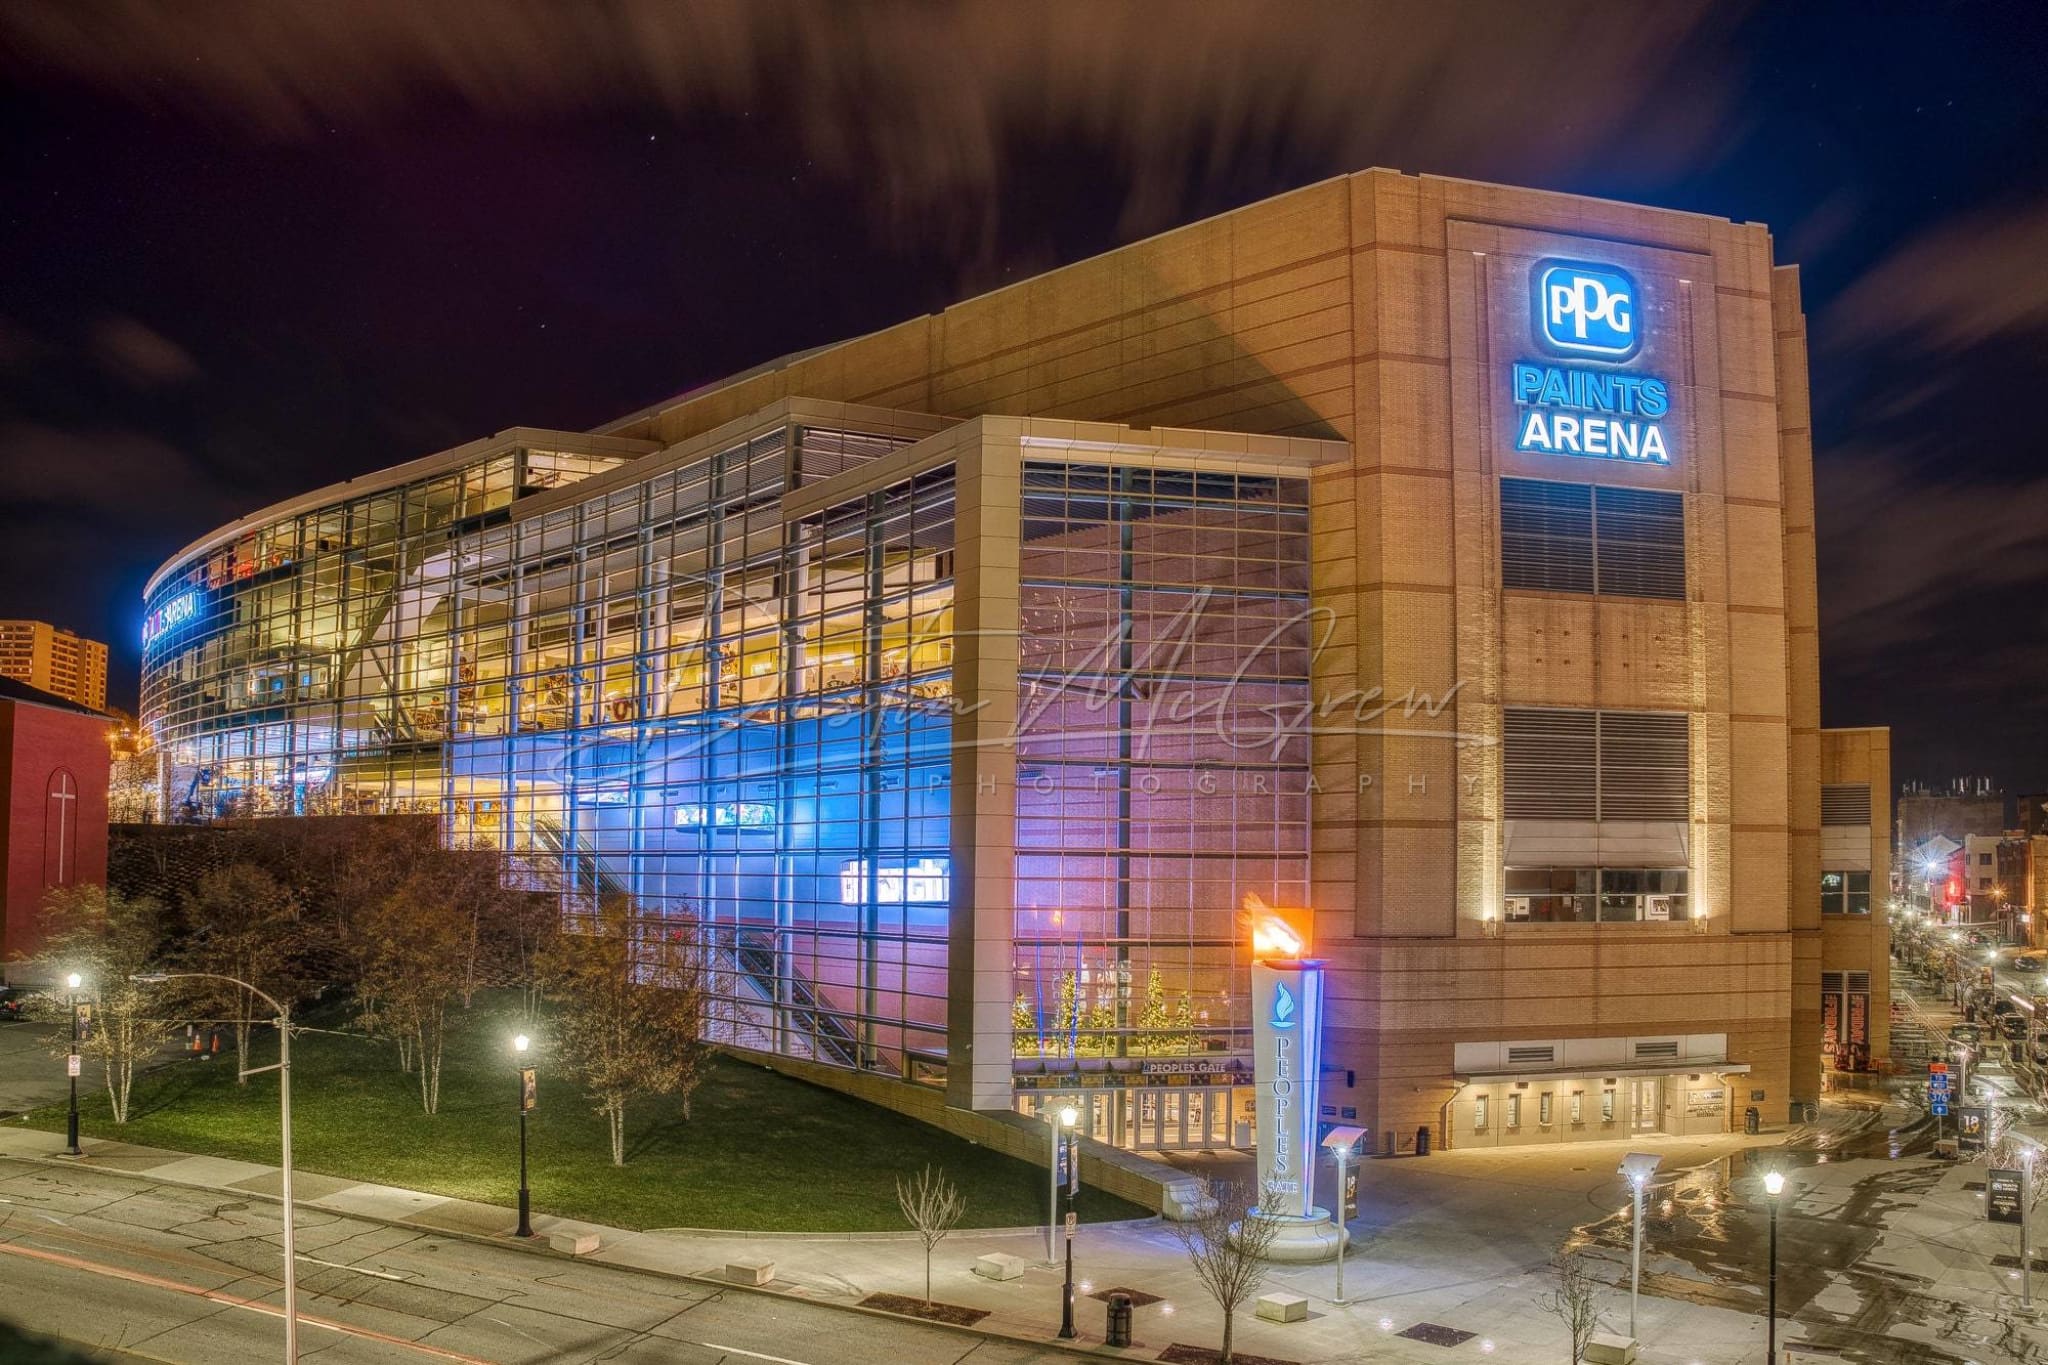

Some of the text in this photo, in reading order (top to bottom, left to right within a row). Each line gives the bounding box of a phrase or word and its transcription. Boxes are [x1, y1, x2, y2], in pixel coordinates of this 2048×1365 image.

[1551, 276, 1631, 339] PPG
[1513, 363, 1669, 419] PAINTS
[1519, 413, 1671, 462] ARENA
[1150, 1063, 1226, 1073] PEOPLES GATE
[1273, 1036, 1291, 1173] PEOPLES
[1931, 1094, 1948, 1103] 376
[1266, 1180, 1297, 1193] GATE
